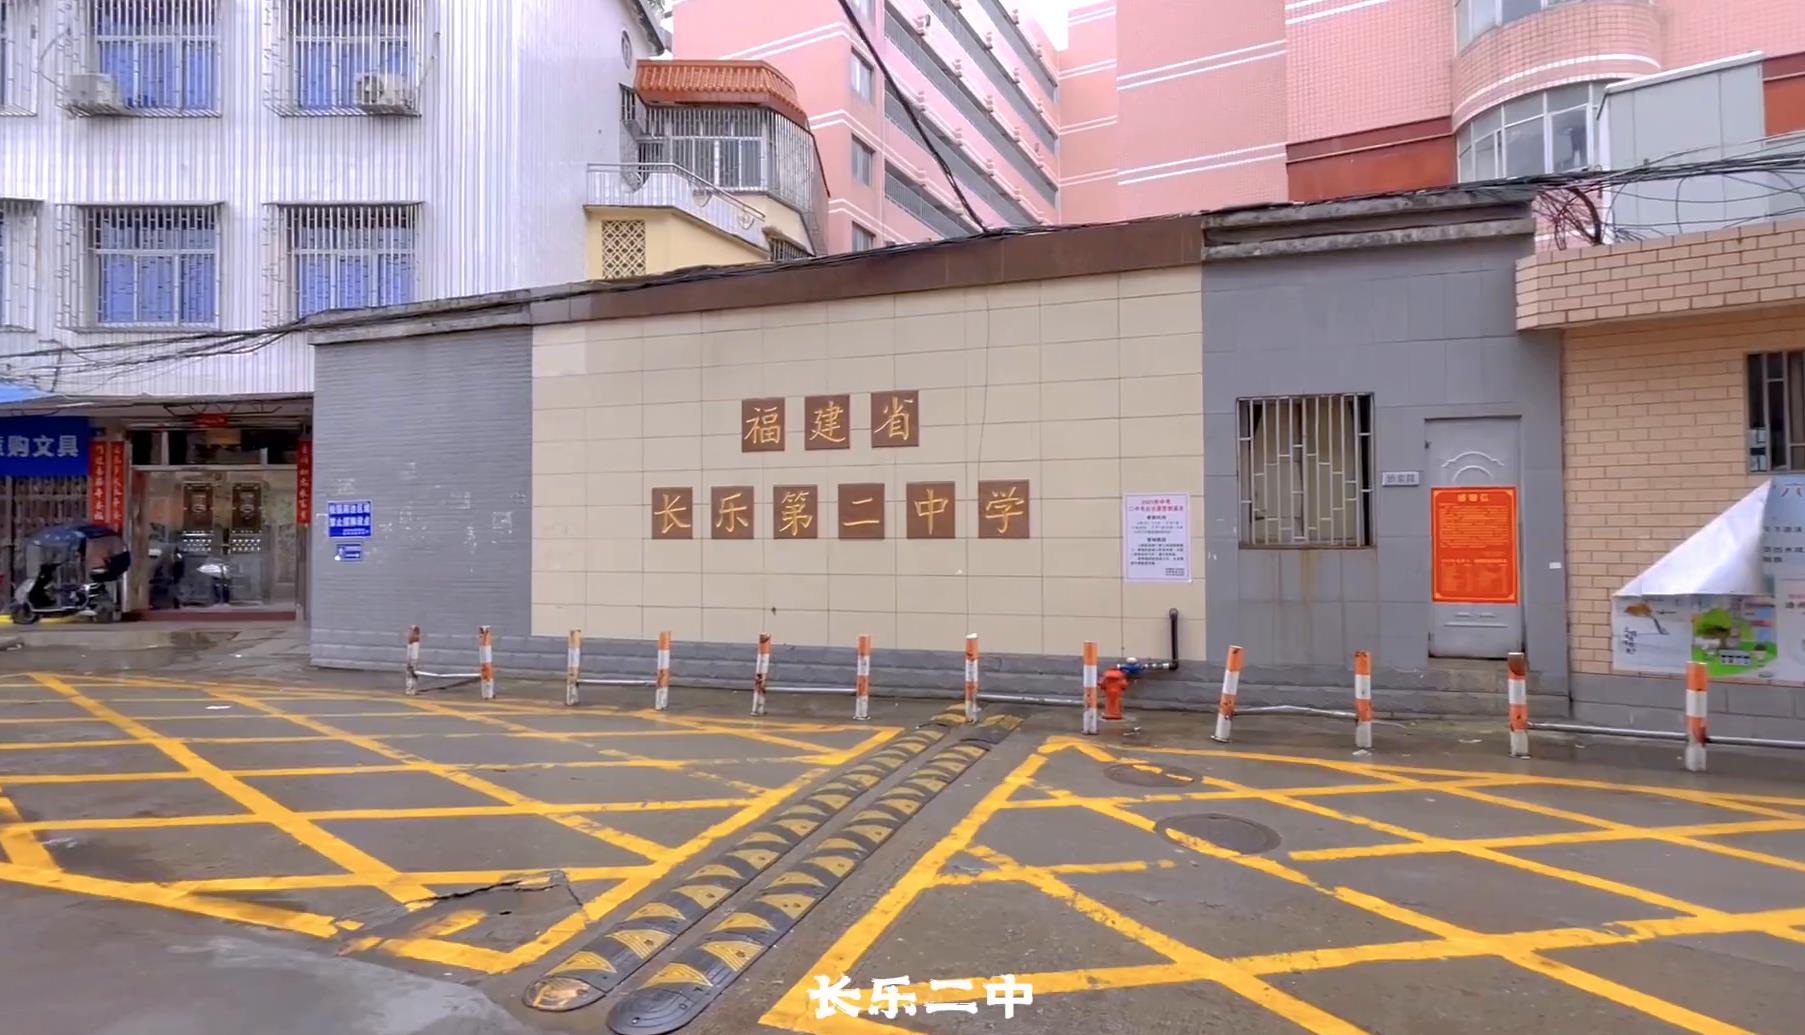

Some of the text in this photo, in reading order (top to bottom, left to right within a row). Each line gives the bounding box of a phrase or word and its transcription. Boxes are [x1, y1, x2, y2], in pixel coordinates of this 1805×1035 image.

[743, 396, 914, 444] 福建省
[0, 434, 79, 456] 购文具
[654, 487, 1025, 536] 长乐第二中学
